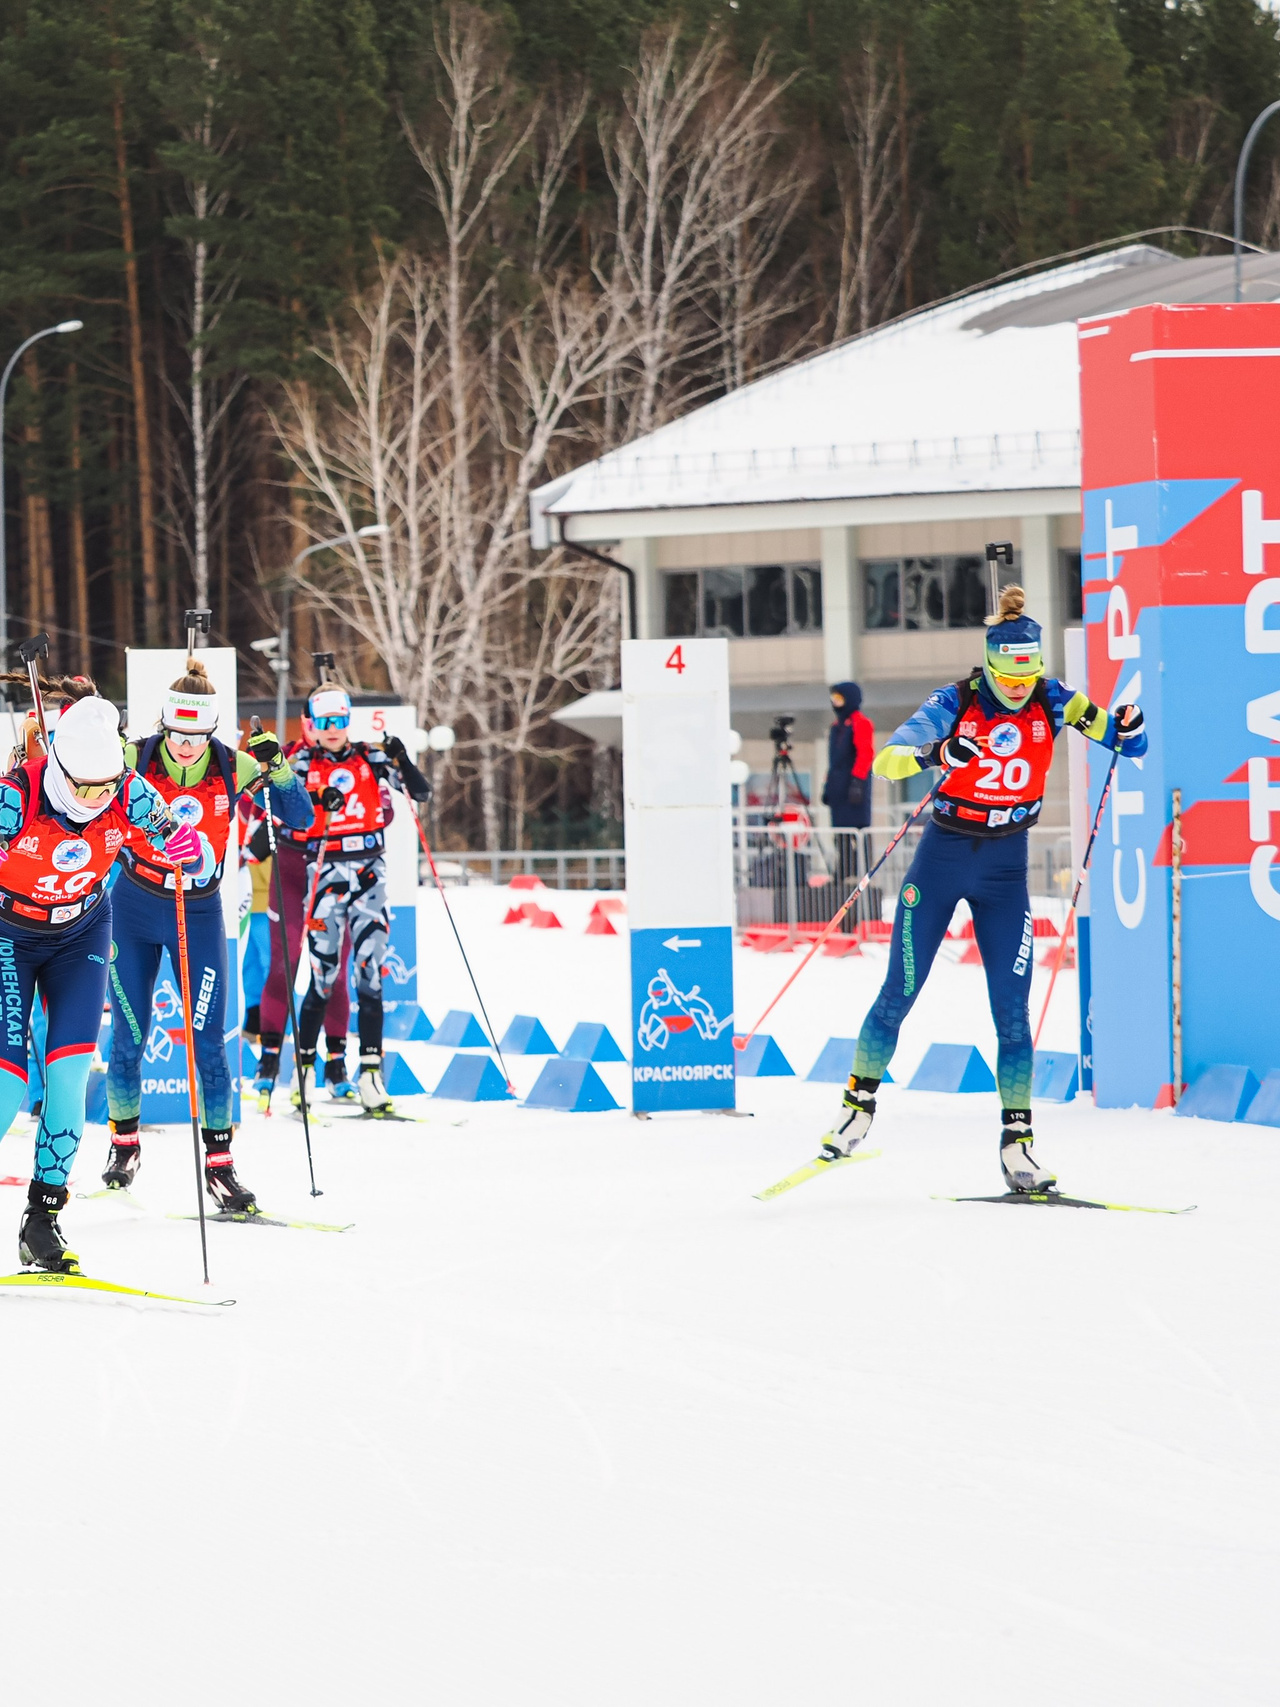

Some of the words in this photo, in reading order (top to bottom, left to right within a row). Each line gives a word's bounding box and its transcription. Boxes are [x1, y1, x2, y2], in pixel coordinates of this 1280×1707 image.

[665, 645, 686, 674] 4
[372, 711, 385, 731] 5
[975, 758, 1030, 790] 20
[198, 966, 217, 1019] BEEU
[633, 1064, 734, 1082] КРАСНОЯРСК
[141, 1076, 239, 1095] КРАСНОК
[1010, 1112, 1026, 1121] 170
[214, 1133, 230, 1142] 169
[42, 1194, 58, 1206] 168
[37, 1274, 66, 1283] FISCHER
